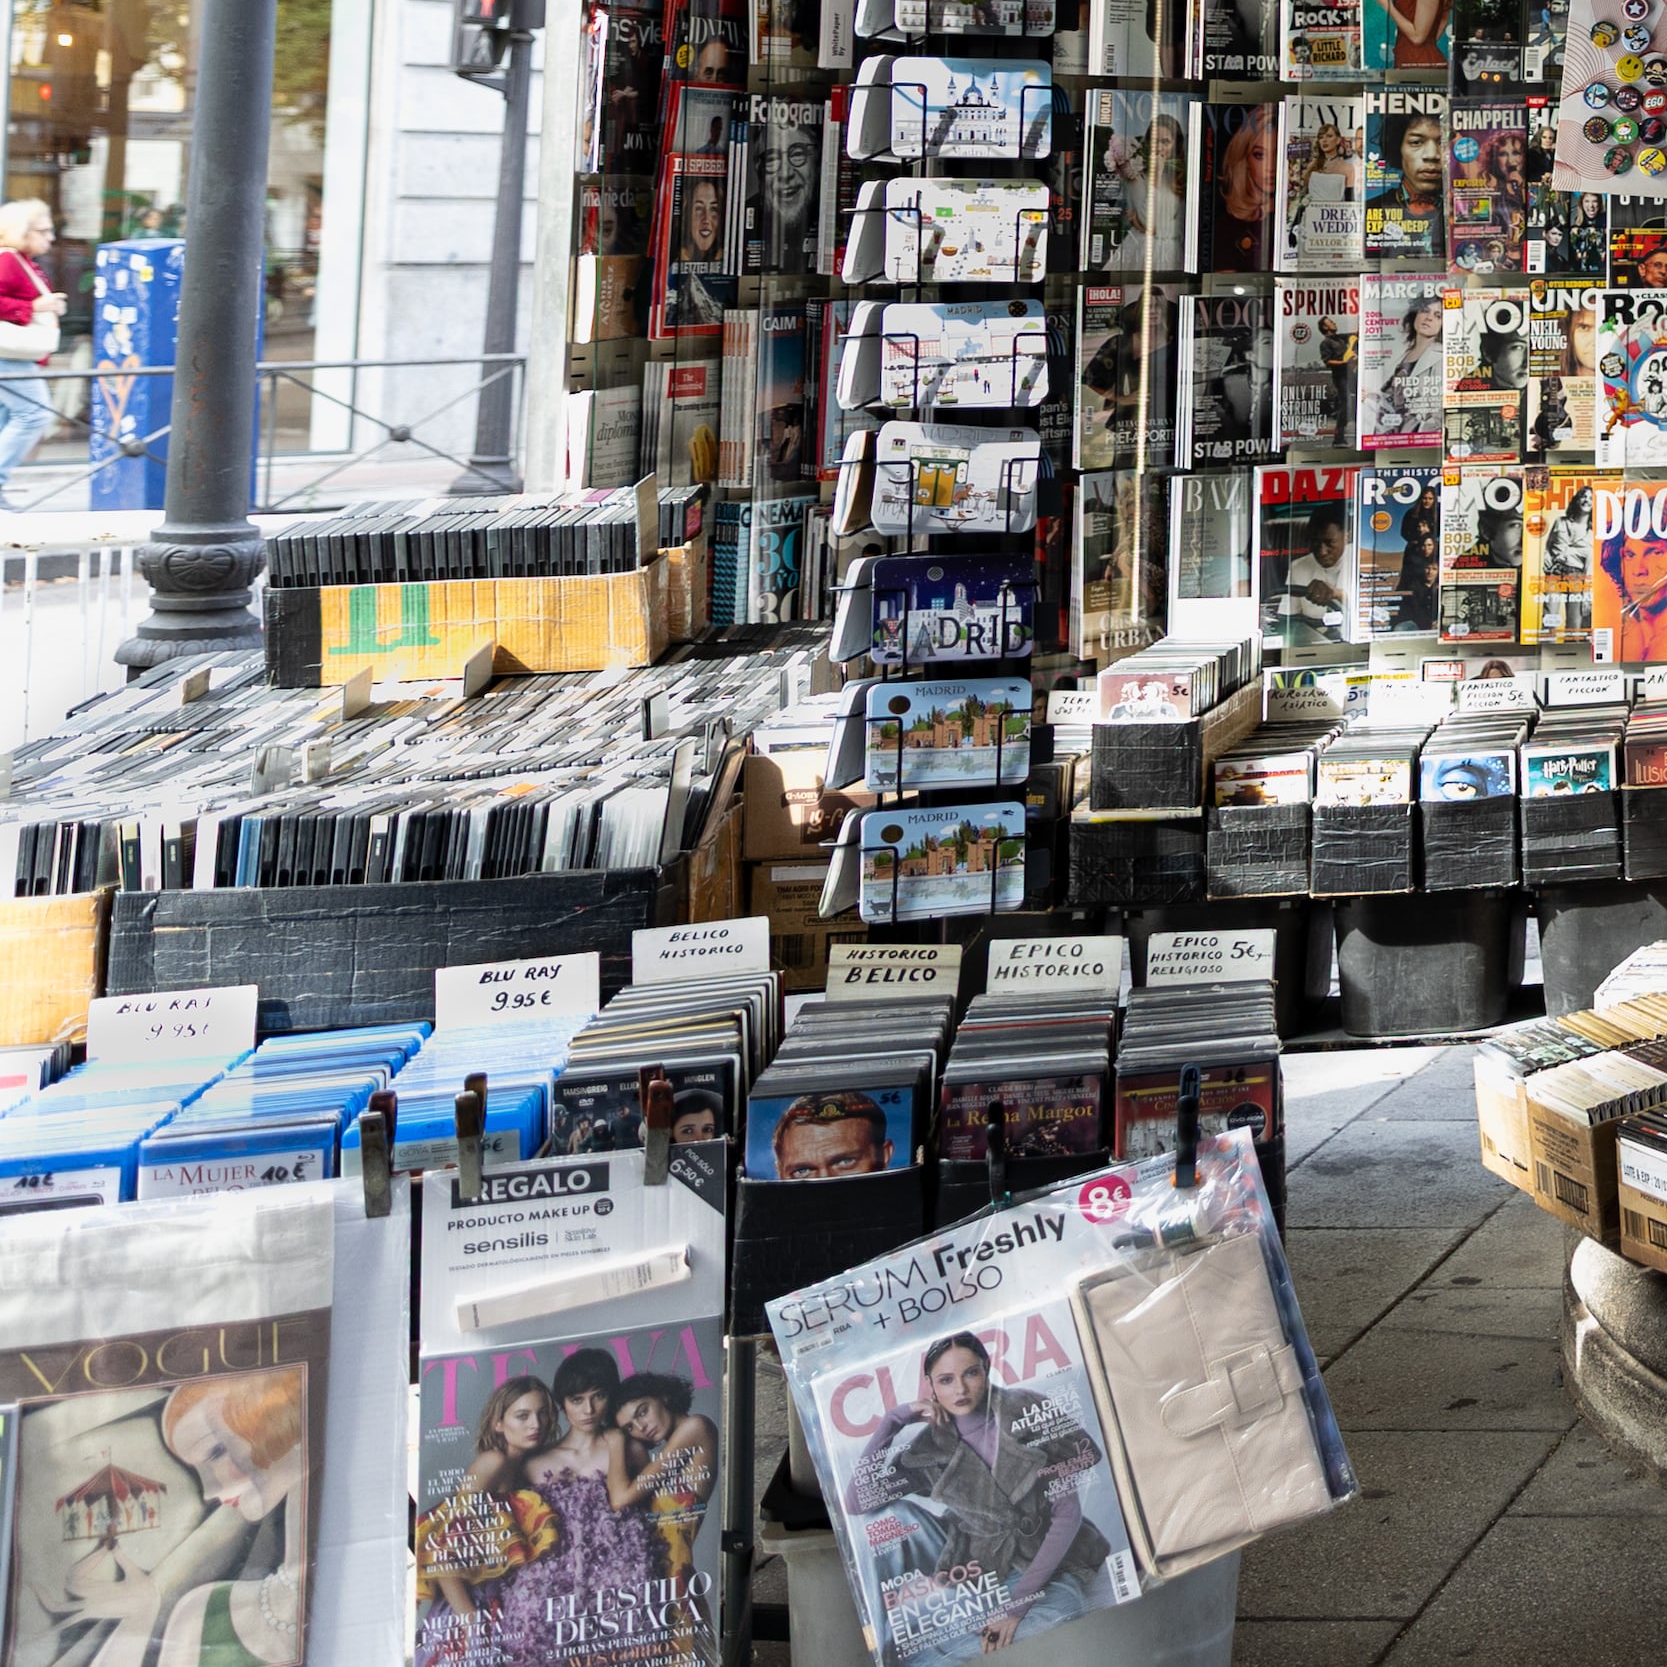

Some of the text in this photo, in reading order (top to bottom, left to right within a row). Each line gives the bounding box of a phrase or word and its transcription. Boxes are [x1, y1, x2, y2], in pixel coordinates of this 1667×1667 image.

[1317, 40, 1342, 52] LITTLE
[1313, 50, 1346, 64] RICHARD
[1453, 111, 1525, 131] CHAPPELL
[1365, 284, 1419, 299] MARC
[947, 303, 983, 316] MADRID
[1529, 320, 1560, 336] NEIL
[1530, 336, 1567, 351] YOUNG
[1447, 356, 1475, 367] BOB
[1447, 367, 1493, 379] DYLAN
[1282, 385, 1327, 402] ONLY THE
[1282, 401, 1320, 416] STRONG
[1444, 532, 1472, 544] BOB
[1444, 543, 1489, 556] DYLAN
[878, 616, 1026, 661] MADRID
[915, 682, 966, 697] MADRID
[908, 810, 959, 825] MADRID
[669, 927, 730, 943] BELICO
[1172, 936, 1219, 949] EPICO
[660, 942, 744, 959] HISTORICO
[847, 948, 939, 961] HISTORICO
[1009, 943, 1084, 961] EPICO
[1150, 950, 1223, 962] HISTORICO
[479, 962, 563, 983] BLU RAY
[846, 964, 937, 983] BELICO
[994, 961, 1104, 981] HISTORICO
[1150, 964, 1223, 975] RELIGIOSO
[1027, 1104, 1094, 1123] Margot
[179, 1164, 256, 1186] MUJER
[447, 1204, 591, 1231] PRODUCTO MAKE UP
[463, 1230, 548, 1255] sensilis
[933, 1212, 1067, 1279] Freshly
[779, 1255, 929, 1338] SERUM
[898, 1264, 1003, 1323] BOLSO
[21, 1319, 298, 1395] VOGUE
[880, 1568, 924, 1593] MODA
[595, 1571, 713, 1613] ESTILO
[888, 1571, 999, 1628] EN CLAVE
[555, 1599, 704, 1646] DESTACA
[891, 1590, 1011, 1645] ELEGANTE
